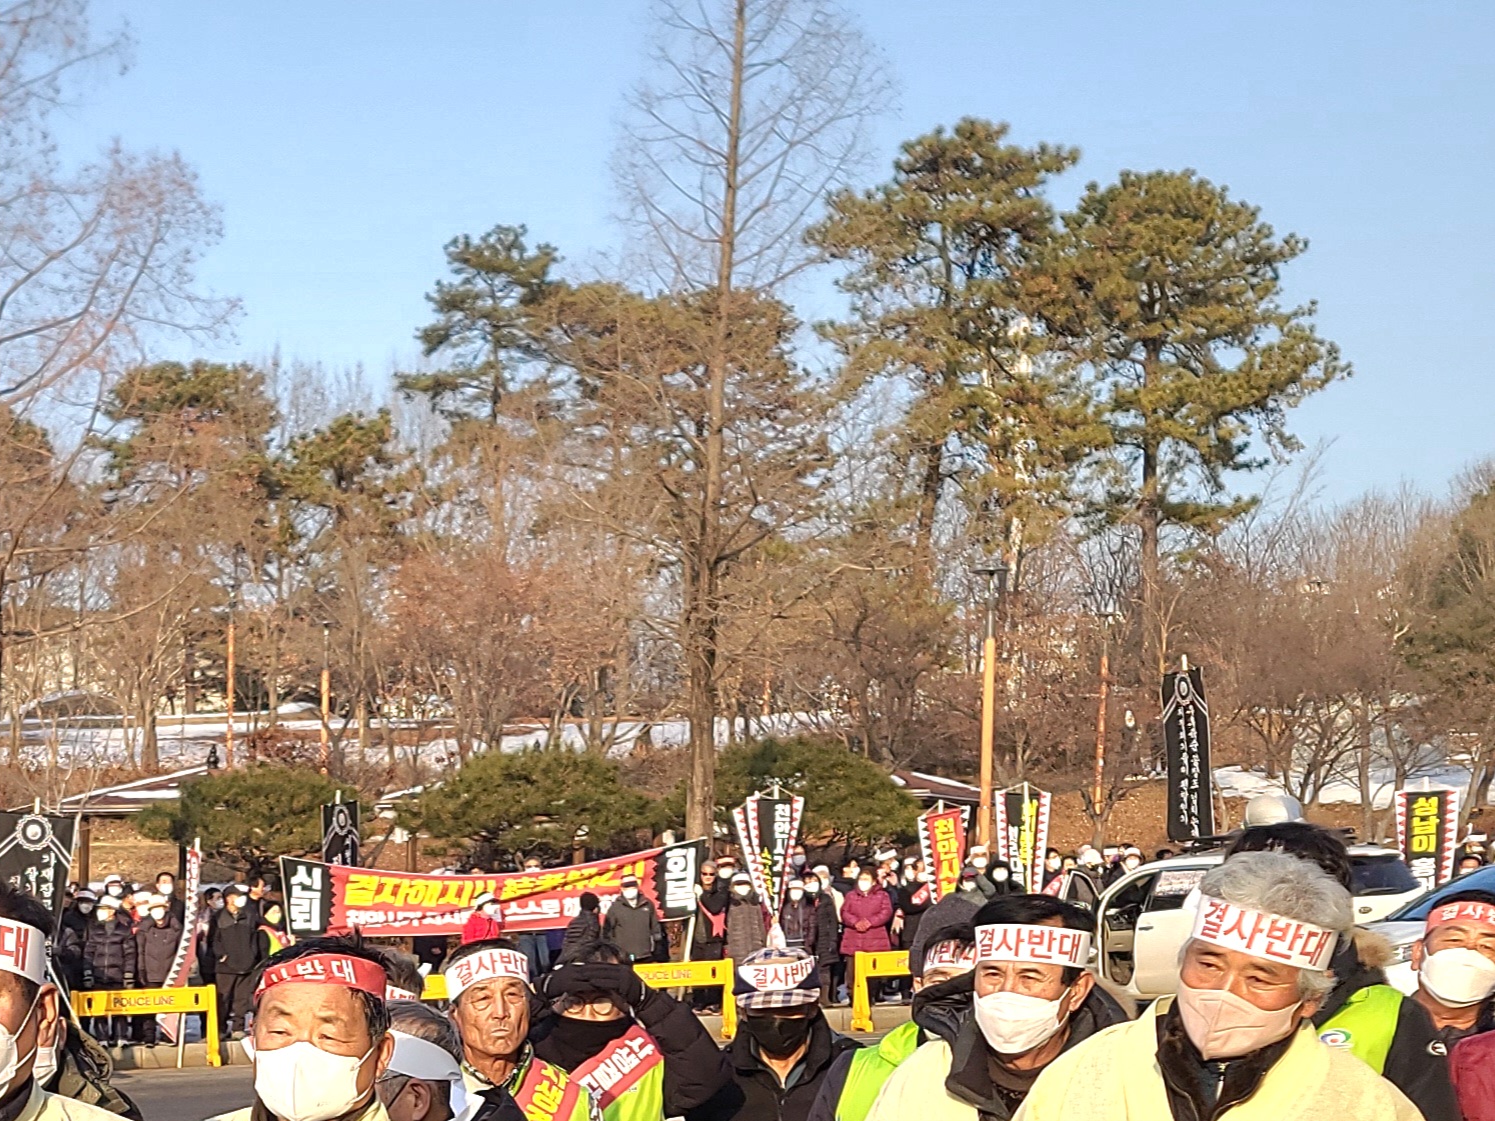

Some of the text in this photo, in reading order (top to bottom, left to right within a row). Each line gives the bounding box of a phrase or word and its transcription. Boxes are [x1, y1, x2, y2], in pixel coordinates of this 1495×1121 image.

[1411, 796, 1440, 853] 성남이
[289, 865, 323, 932] 신뢰
[979, 927, 1083, 964] 결사반대
[1200, 900, 1333, 967] 결사반대
[113, 995, 176, 1008] POLICE LINE
